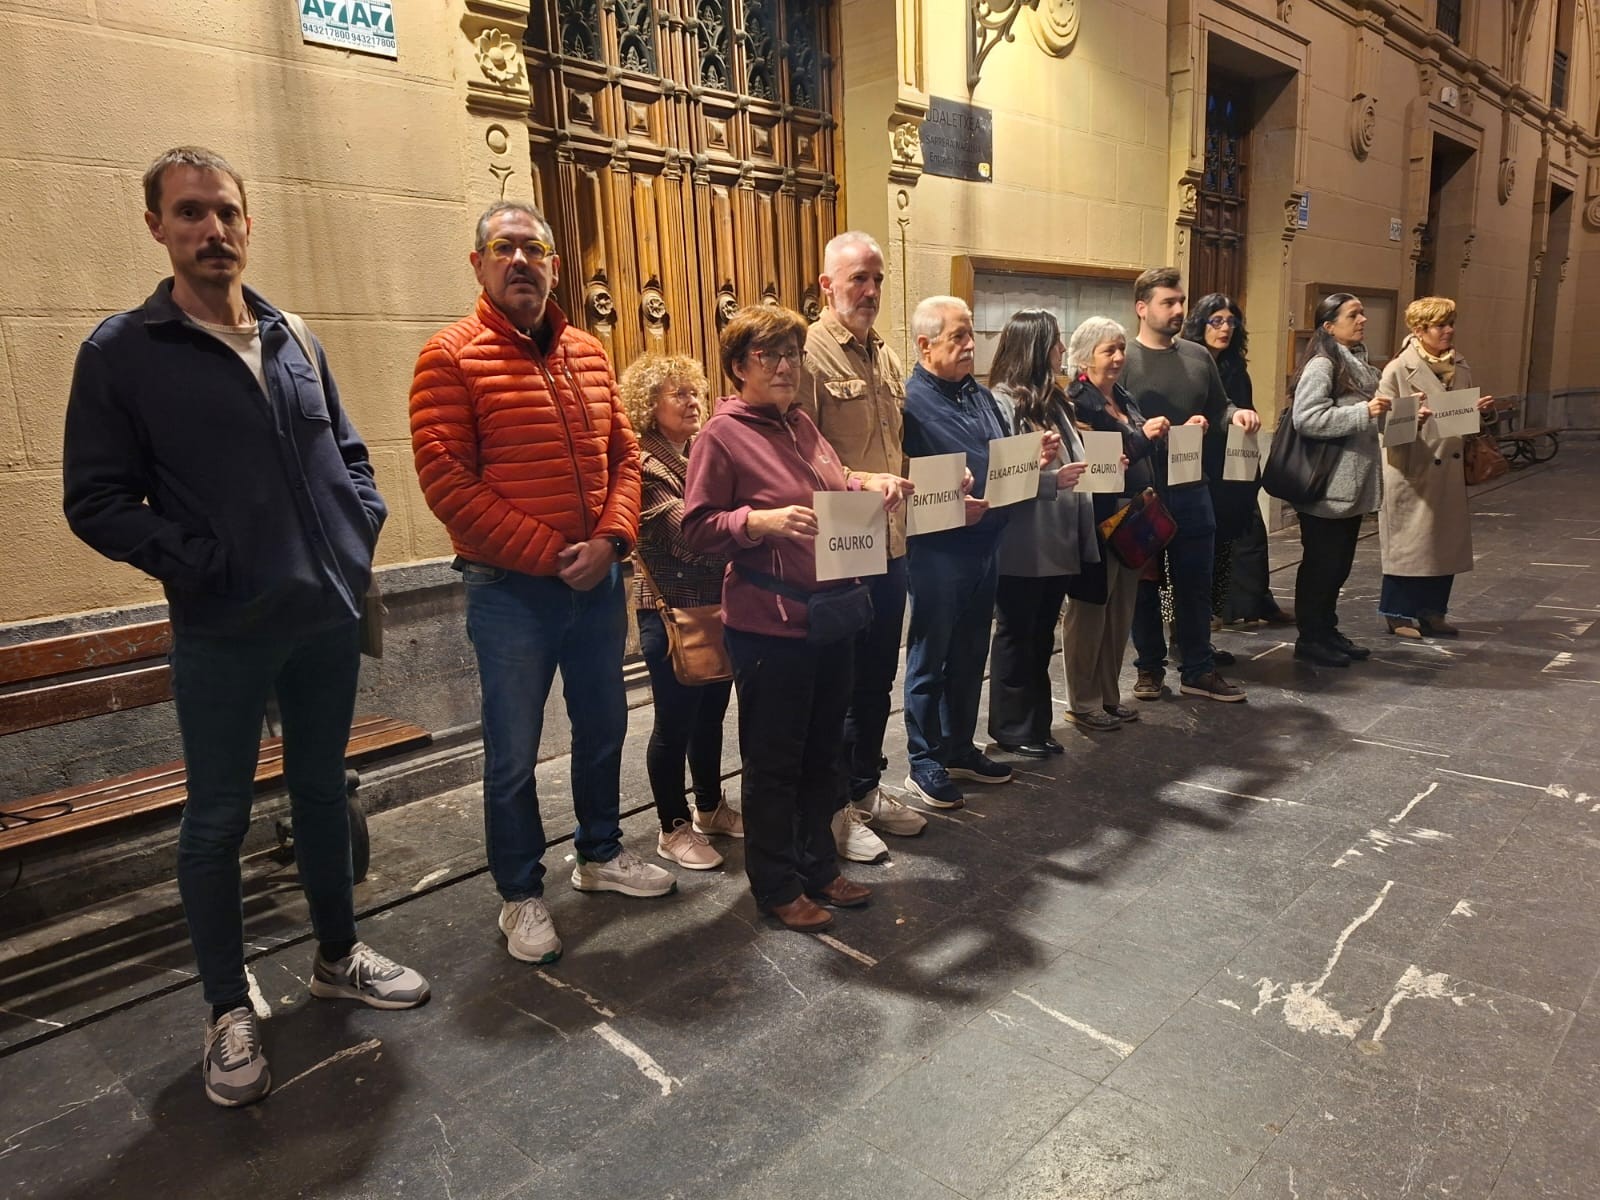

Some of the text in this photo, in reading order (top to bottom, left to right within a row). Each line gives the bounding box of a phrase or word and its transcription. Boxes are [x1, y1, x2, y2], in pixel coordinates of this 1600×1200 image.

[302, 23, 350, 40] 943217800
[351, 33, 396, 49] 943217800
[989, 460, 1039, 481] ELKARTASUNA
[1090, 463, 1117, 475] GAURKO
[913, 488, 960, 507] BIKTIMEKIN
[828, 534, 874, 552] GAURKO
